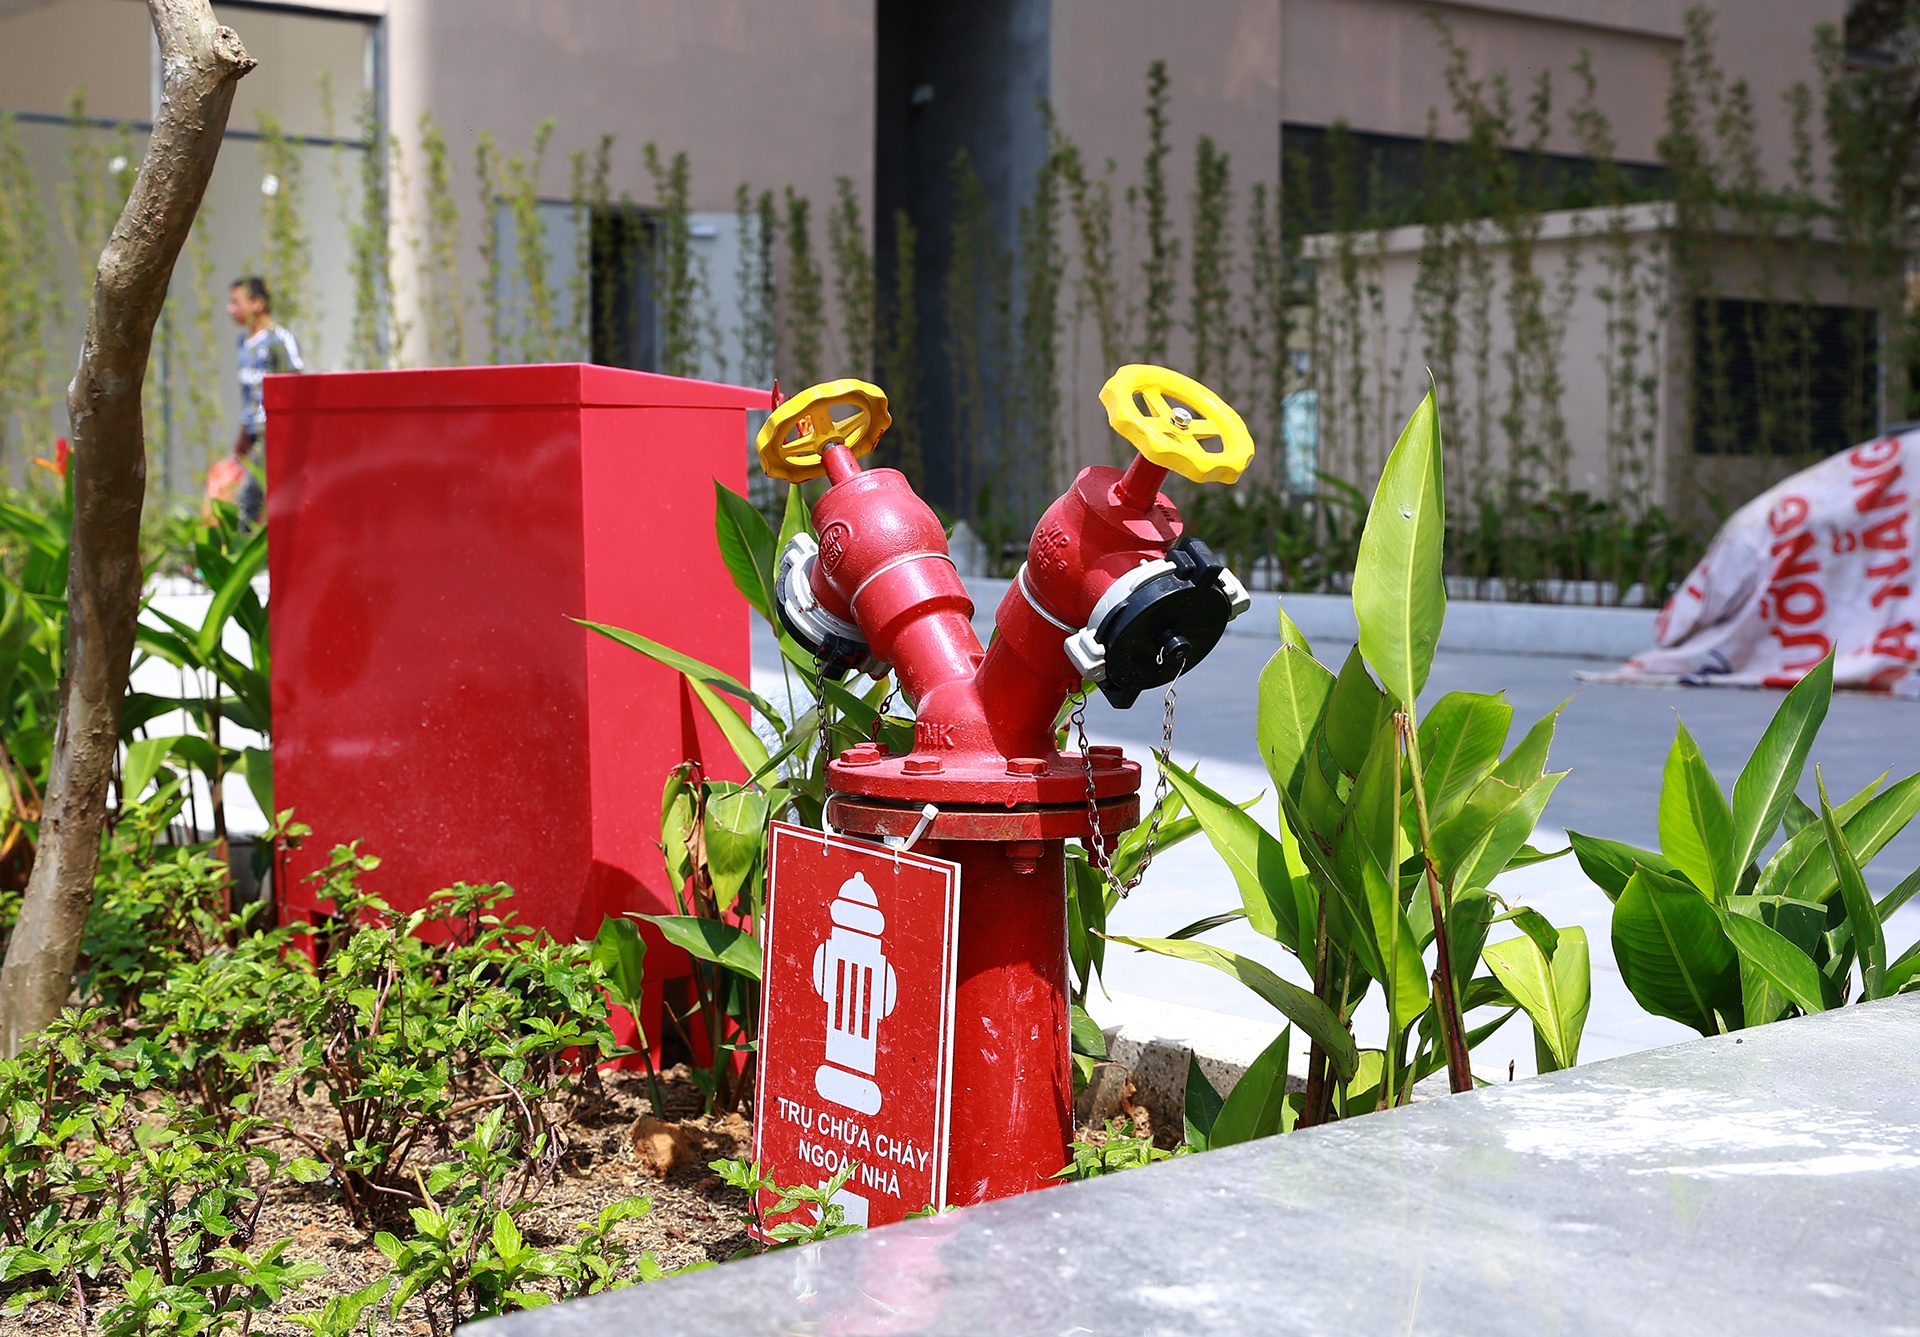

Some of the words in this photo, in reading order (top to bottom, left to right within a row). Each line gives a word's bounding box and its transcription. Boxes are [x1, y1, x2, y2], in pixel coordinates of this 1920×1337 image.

[1761, 496, 1832, 687] ƯỠNG
[777, 1096, 813, 1134] TRỤ
[817, 1112, 871, 1152] CHỮA
[875, 1134, 930, 1172] CHÁY
[861, 1162, 901, 1199] NHÀ
